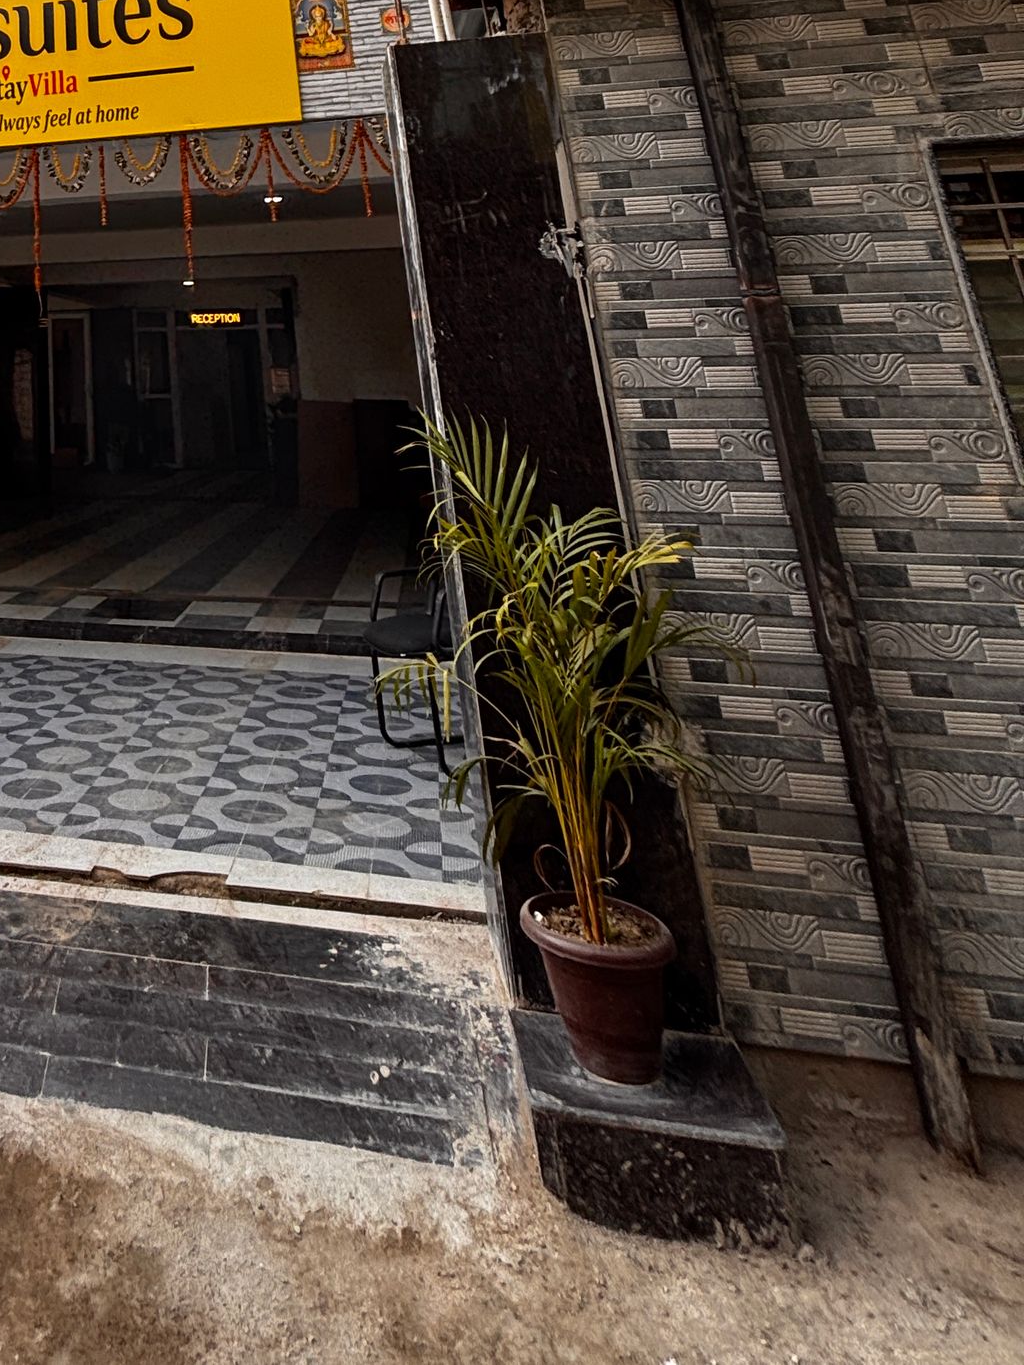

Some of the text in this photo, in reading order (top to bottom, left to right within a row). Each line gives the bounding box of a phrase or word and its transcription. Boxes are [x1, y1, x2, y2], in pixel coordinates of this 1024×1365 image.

[42, 108, 72, 133] feel
[76, 110, 92, 125] at
[96, 104, 139, 123] home
[190, 313, 241, 324] RECEPTION
